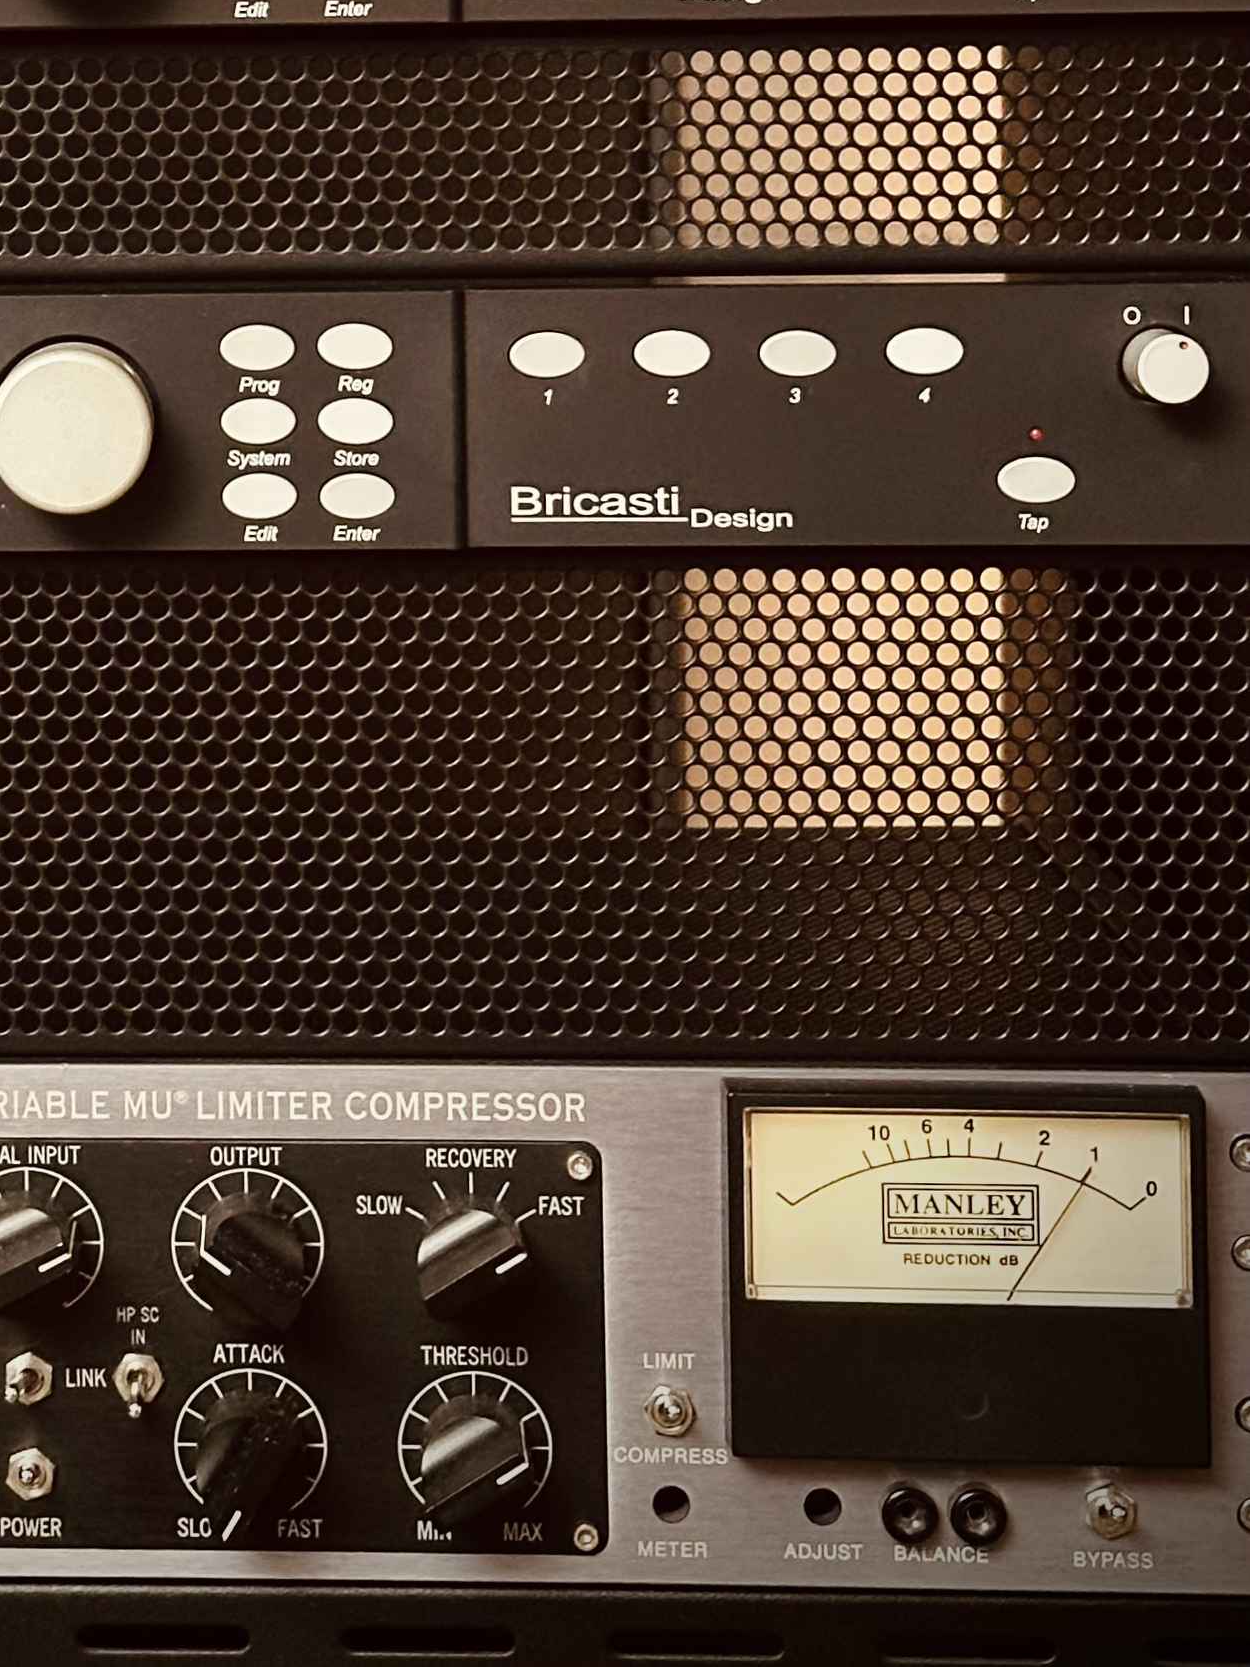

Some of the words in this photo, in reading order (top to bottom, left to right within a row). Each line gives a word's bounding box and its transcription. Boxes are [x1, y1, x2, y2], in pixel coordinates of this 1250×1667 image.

[234, 1, 270, 18] Edit
[324, 0, 373, 17] Enter
[239, 376, 281, 396] Prog
[338, 375, 374, 395] Reg
[543, 389, 552, 404] 1
[666, 388, 680, 404] 2
[788, 388, 802, 404] 3
[918, 387, 931, 403] 4
[227, 450, 291, 470] System
[333, 450, 379, 467] Store
[510, 485, 681, 517] Bricasti
[690, 507, 794, 531] Design
[1018, 513, 1048, 533] Tap
[243, 525, 279, 542] Edit
[333, 525, 381, 542] Enter
[196, 1091, 334, 1121] LIMITER
[345, 1092, 587, 1123] COMPRESSOR
[28, 1146, 81, 1165] INPUT
[210, 1148, 282, 1166] OUTPUT
[425, 1149, 517, 1168] RECOVERY
[868, 1125, 891, 1141] 10
[921, 1119, 932, 1134] 6
[963, 1118, 975, 1134] 4
[1039, 1130, 1050, 1146] 2
[1089, 1147, 1098, 1162] 1
[1146, 1182, 1158, 1198] 0
[356, 1196, 402, 1215] SLOW
[538, 1197, 584, 1216] FAST
[894, 1194, 1026, 1216] MANLEY
[903, 1253, 991, 1265] REDUCTION
[999, 1255, 1019, 1266] dB
[116, 1308, 136, 1323] HP
[141, 1308, 159, 1323] SC
[131, 1330, 146, 1345] IN
[213, 1345, 285, 1364] ATTACK
[421, 1346, 529, 1366] THRESHOLD
[643, 1353, 695, 1370] LIMIT
[65, 1369, 106, 1388] LINK
[613, 1447, 729, 1466] COMPRESS
[0, 1519, 62, 1538] POWER
[278, 1520, 323, 1539] FAST
[503, 1523, 543, 1541] MAX
[637, 1541, 708, 1559] METER
[784, 1544, 863, 1562] ADJUST
[894, 1546, 989, 1564] BALANCE
[1073, 1551, 1154, 1570] BYPASS
